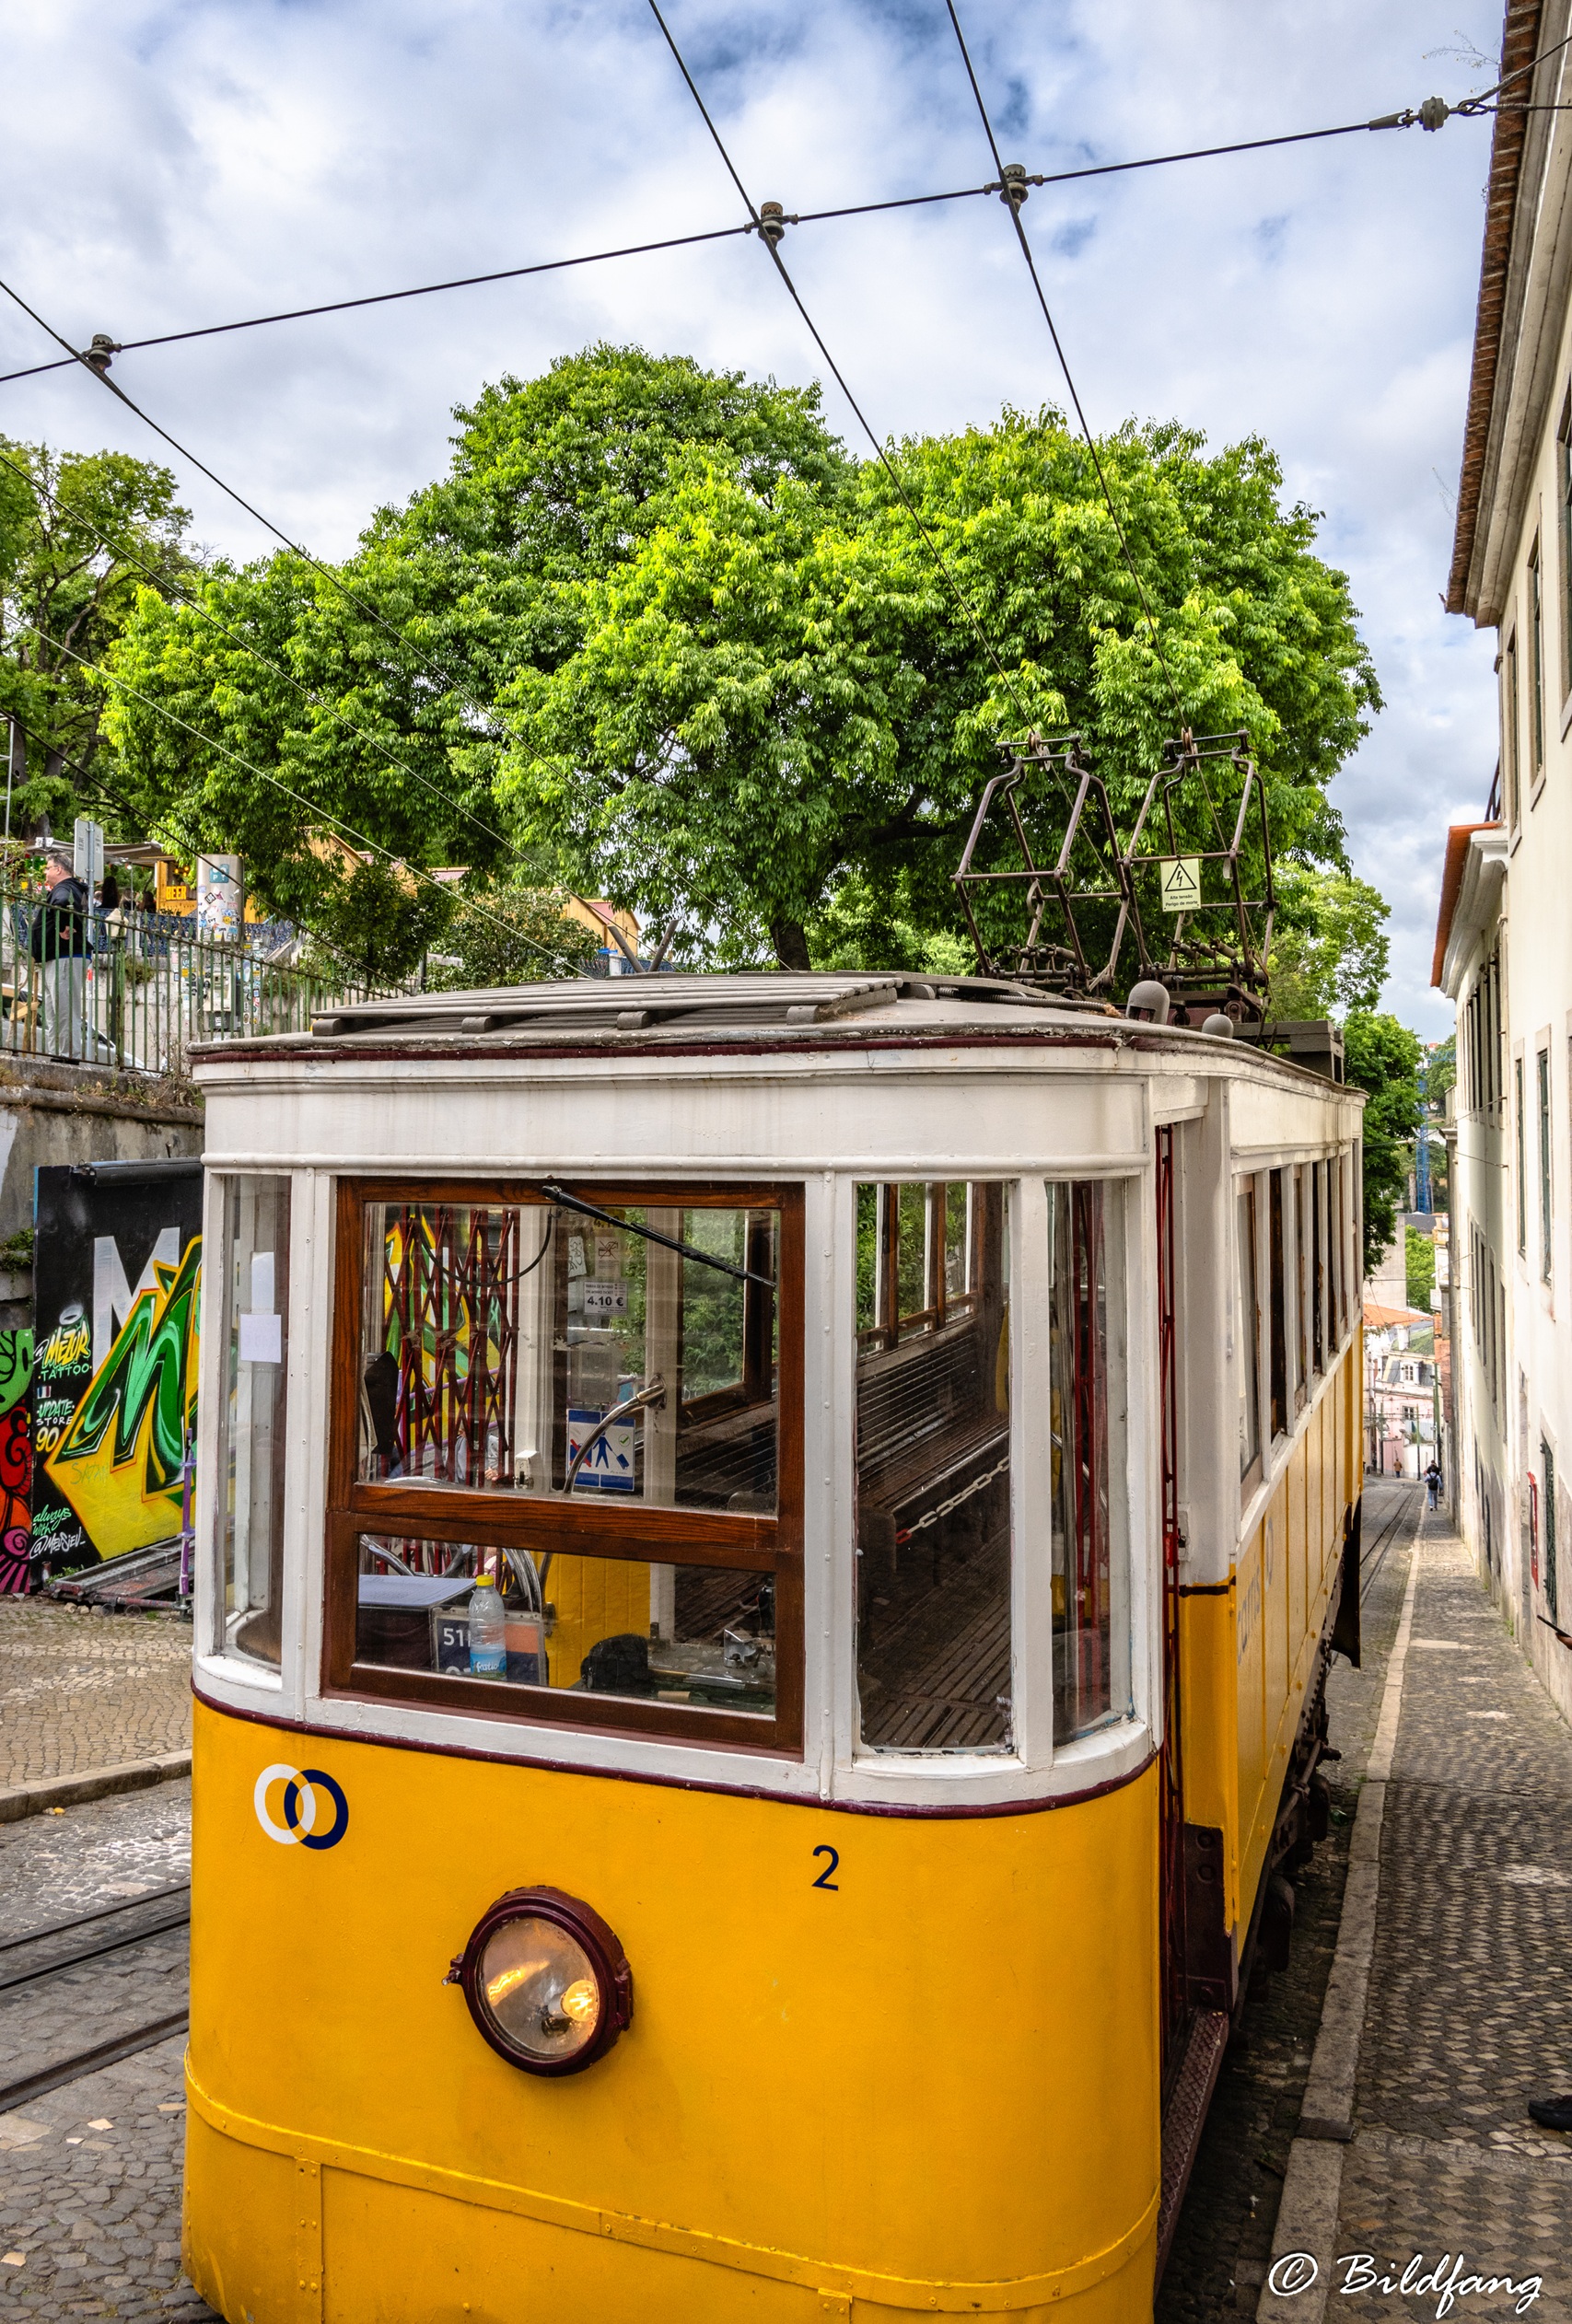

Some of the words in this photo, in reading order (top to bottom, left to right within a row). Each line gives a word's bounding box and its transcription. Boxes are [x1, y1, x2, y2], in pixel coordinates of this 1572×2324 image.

[166, 886, 187, 900] BEER
[588, 1296, 612, 1306] 4.10
[616, 1296, 624, 1307] €
[41, 1364, 90, 1381] TATTOO
[39, 1399, 73, 1418] UPDATE
[36, 1415, 74, 1426] STORE
[36, 1426, 60, 1452] 90
[33, 1504, 72, 1531] always
[443, 1627, 472, 1648] 51
[811, 1844, 840, 1891] 2
